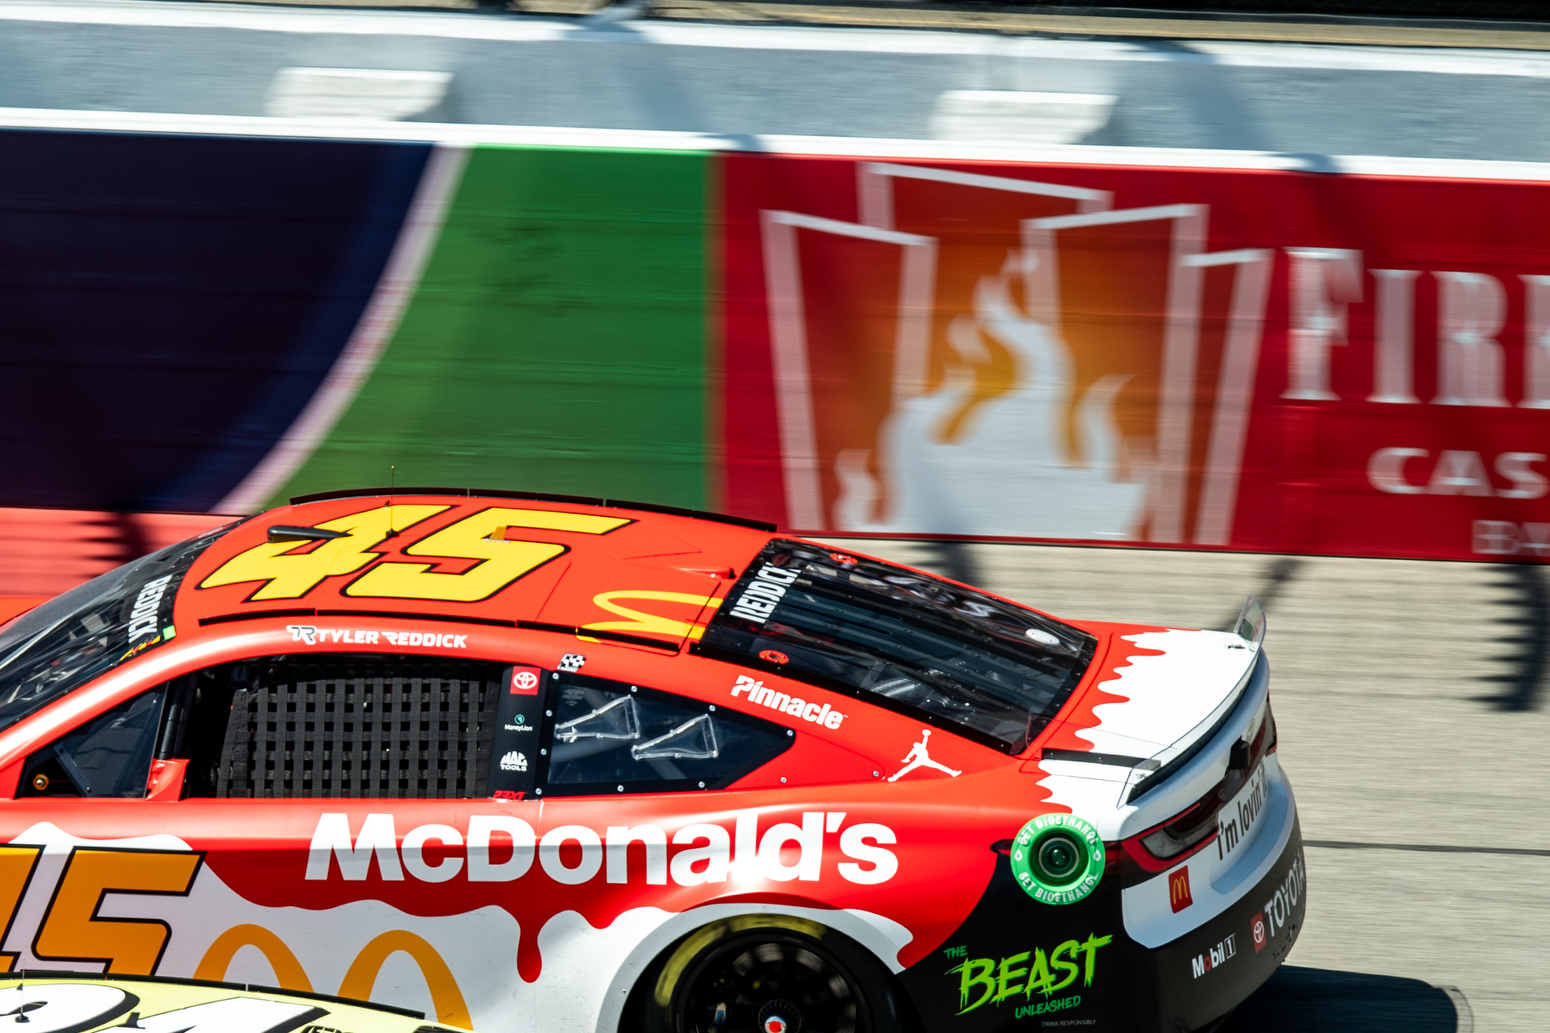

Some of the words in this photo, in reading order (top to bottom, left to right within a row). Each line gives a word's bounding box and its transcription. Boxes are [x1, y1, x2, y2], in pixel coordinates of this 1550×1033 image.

[1366, 447, 1550, 499] CAS
[194, 504, 638, 602] 45
[128, 575, 172, 643] REDDICK
[317, 629, 379, 644] TYLER
[381, 631, 468, 648] REDDICK
[731, 675, 844, 729] Pinnacle
[500, 751, 528, 766] MAC
[304, 811, 899, 885] McDonald's
[1264, 852, 1305, 937] TOYOTA
[943, 945, 968, 959] THE
[945, 932, 1113, 1015] BEAST
[1192, 942, 1225, 979] Mobil
[1015, 995, 1081, 1019] UNLEASHED
